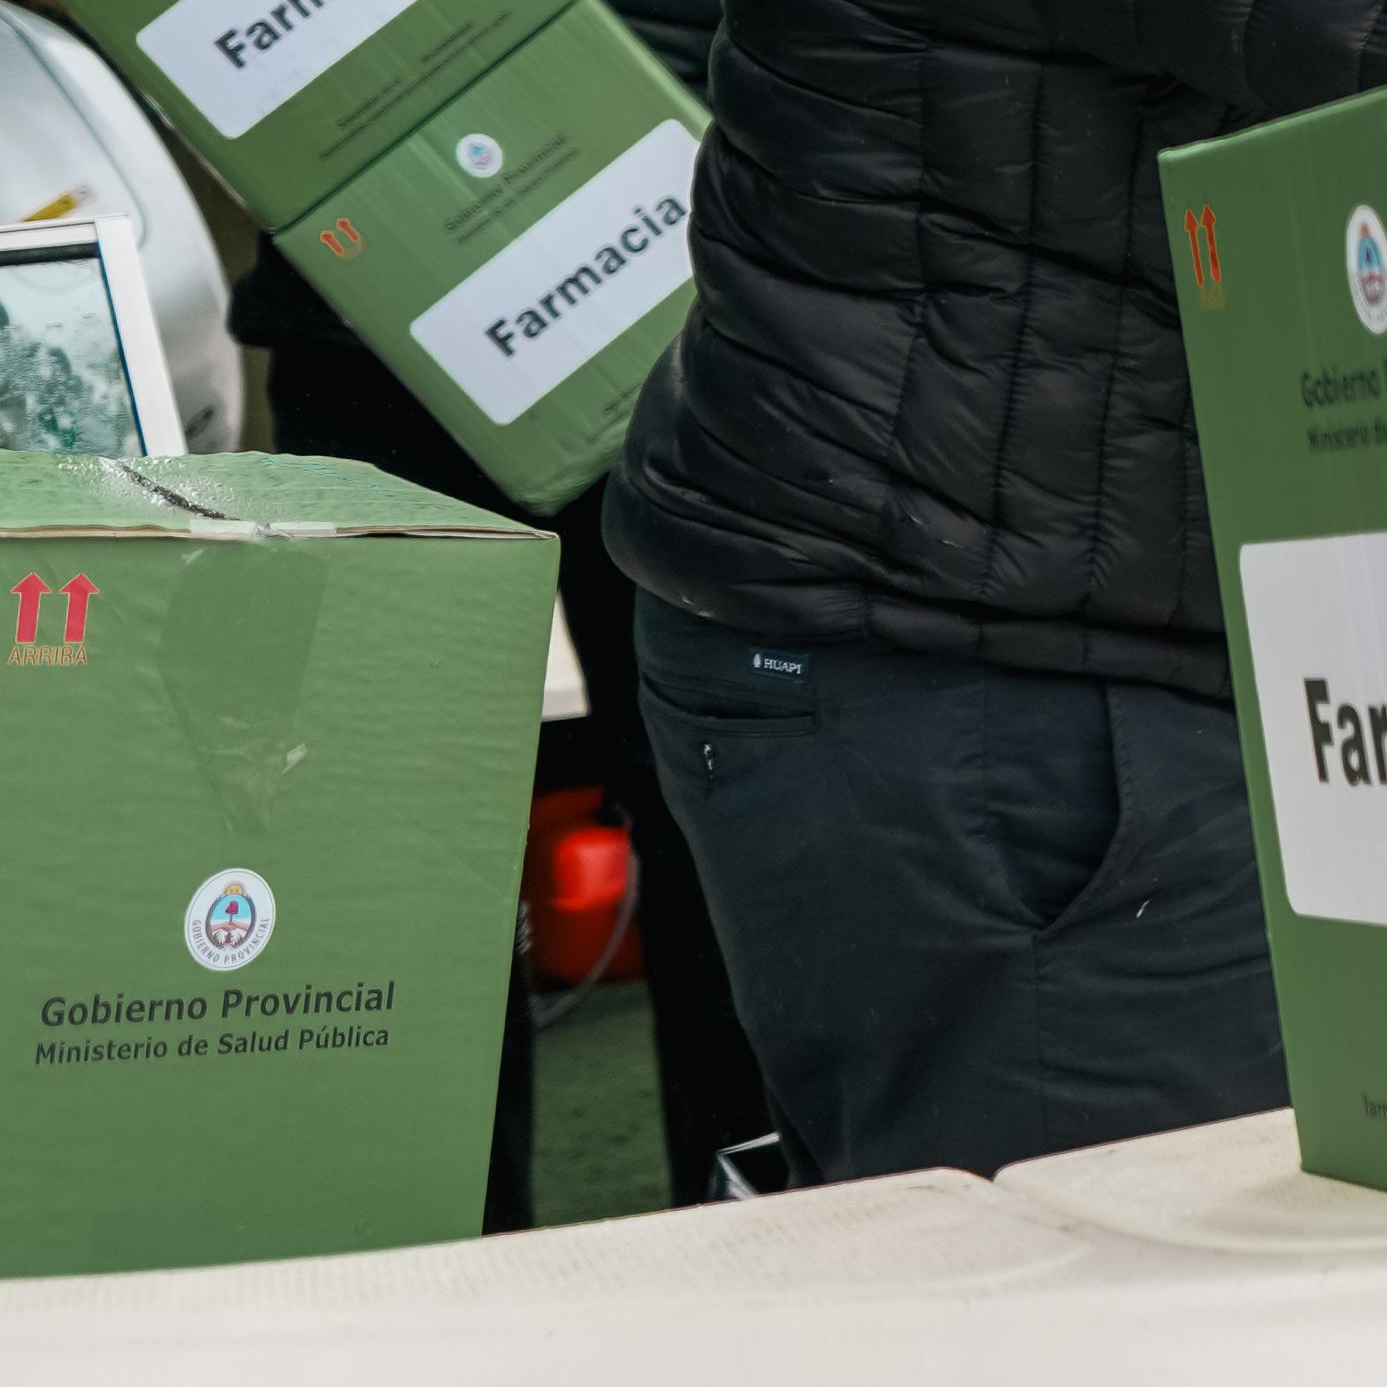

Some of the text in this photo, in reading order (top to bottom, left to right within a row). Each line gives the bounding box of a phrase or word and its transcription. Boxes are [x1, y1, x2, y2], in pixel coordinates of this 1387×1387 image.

[484, 197, 688, 357] Farmacia
[7, 644, 88, 666] ARRIBA
[41, 981, 395, 1027] Gobierno Provincial
[35, 1025, 390, 1064] Ministerio de Salud Pública
